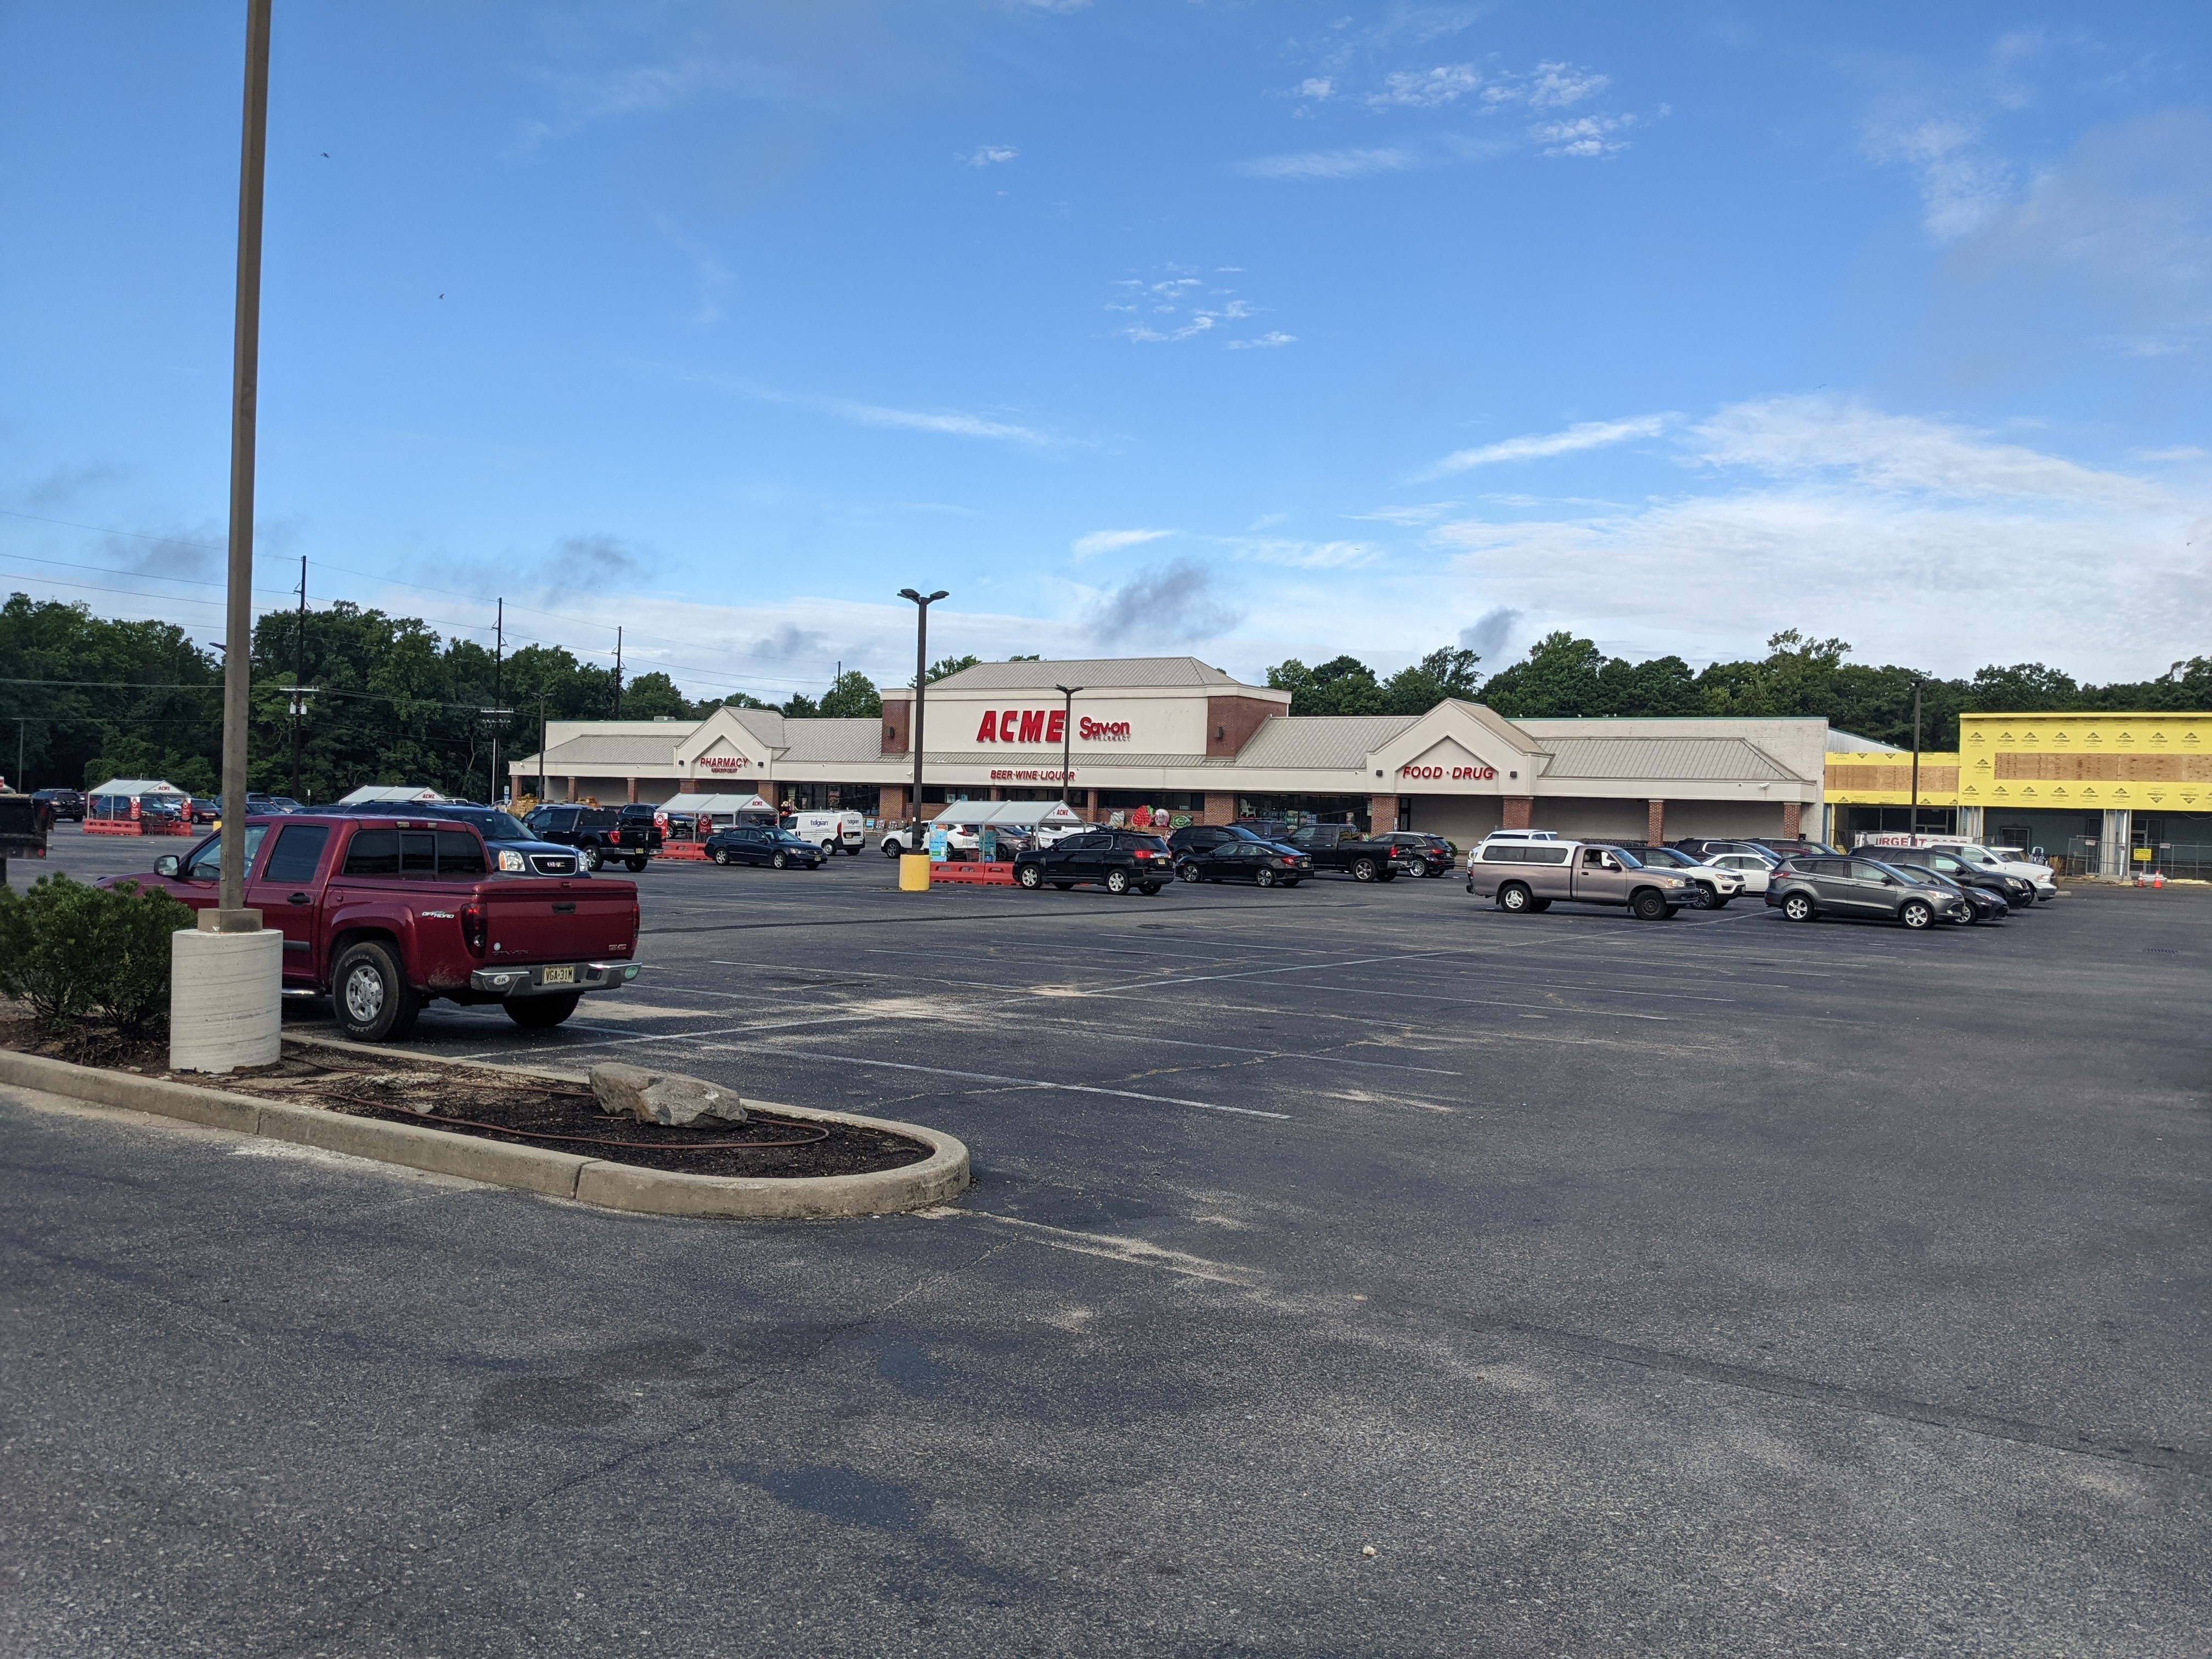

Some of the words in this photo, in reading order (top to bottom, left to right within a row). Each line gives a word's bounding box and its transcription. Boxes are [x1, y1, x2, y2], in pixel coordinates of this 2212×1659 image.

[976, 710, 1066, 742] ACME
[700, 758, 748, 768] PHARMACY
[1402, 766, 1443, 779] FOOD
[1452, 767, 1494, 780] DRUG
[1875, 837, 1927, 847] URGET
